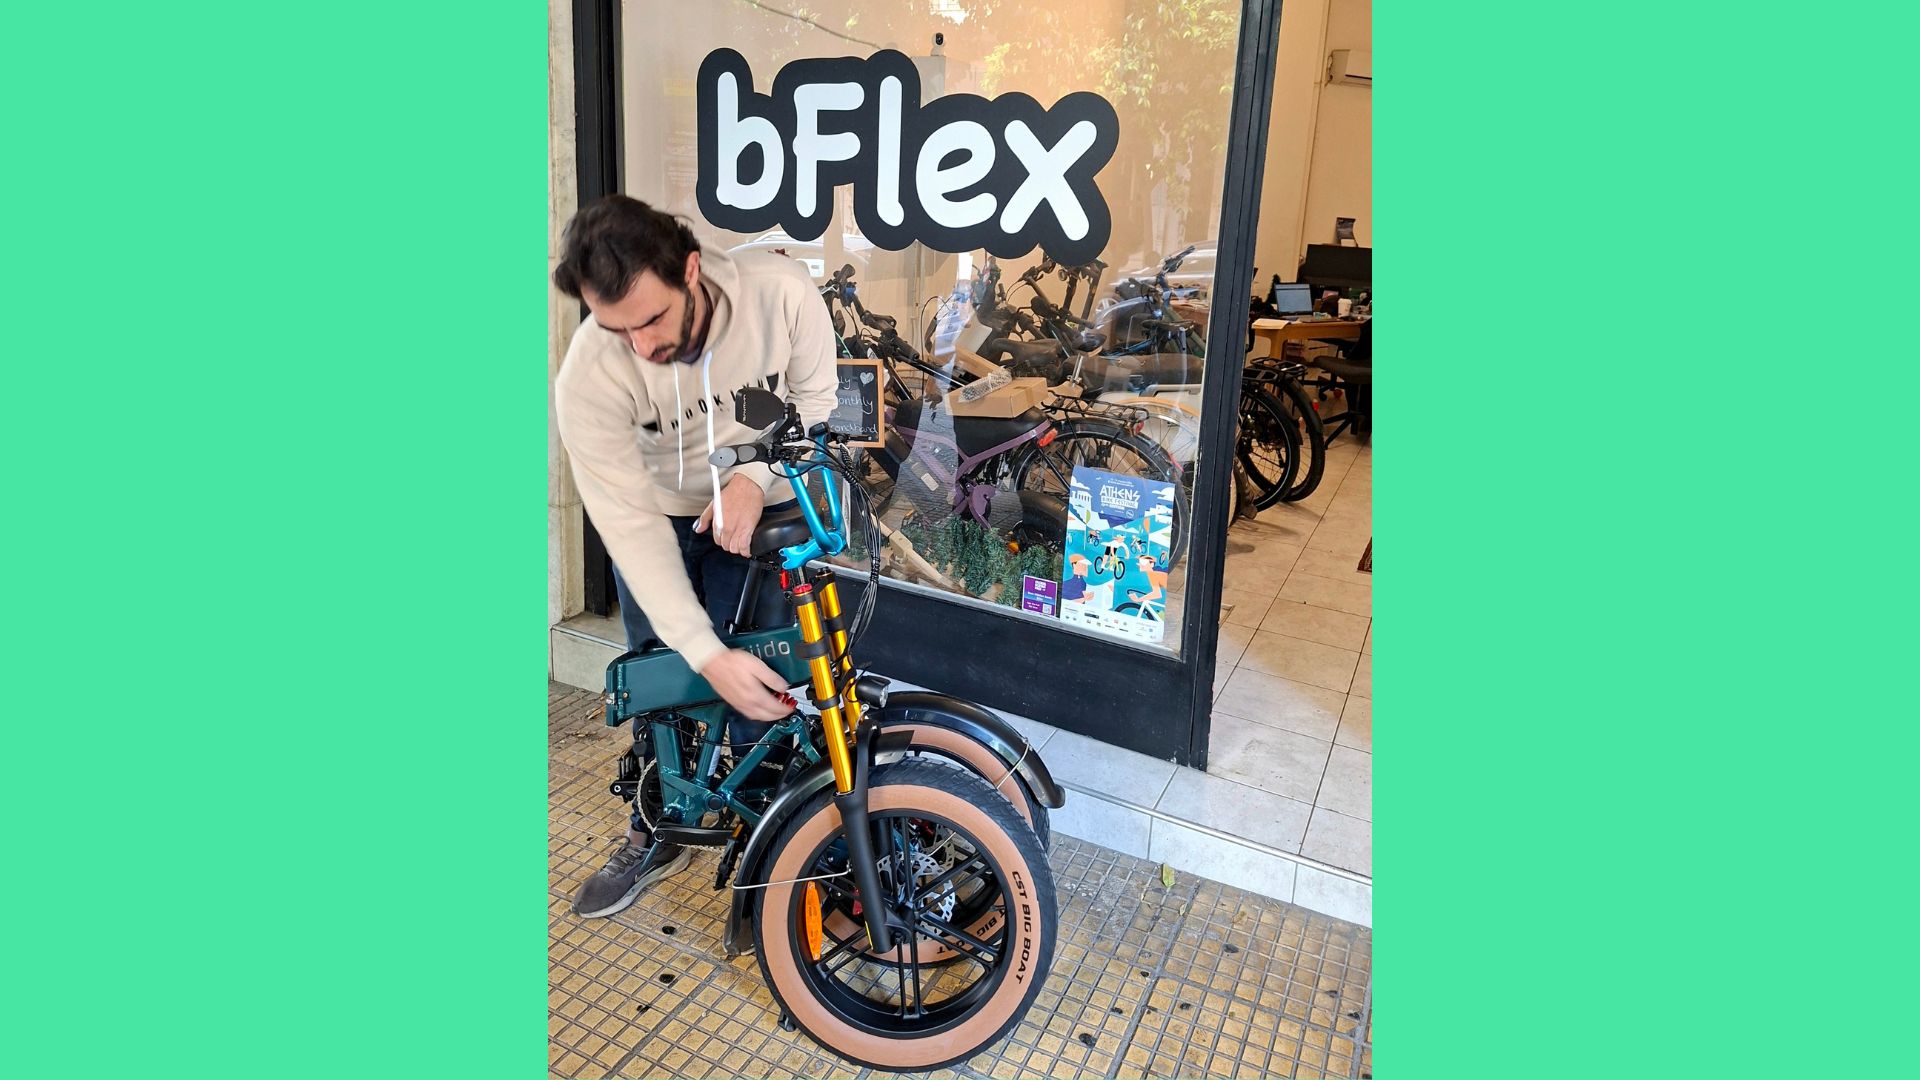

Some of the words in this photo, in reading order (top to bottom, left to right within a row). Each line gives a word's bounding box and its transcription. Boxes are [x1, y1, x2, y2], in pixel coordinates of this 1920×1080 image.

[716, 71, 1098, 241] bFlex
[837, 395, 874, 415] onthly
[1099, 484, 1141, 503] ATHENS
[749, 640, 790, 659] iido
[1011, 870, 1028, 899] CST
[976, 916, 998, 937] BIG
[1022, 903, 1032, 933] BIG
[1015, 937, 1032, 985] BOAT
